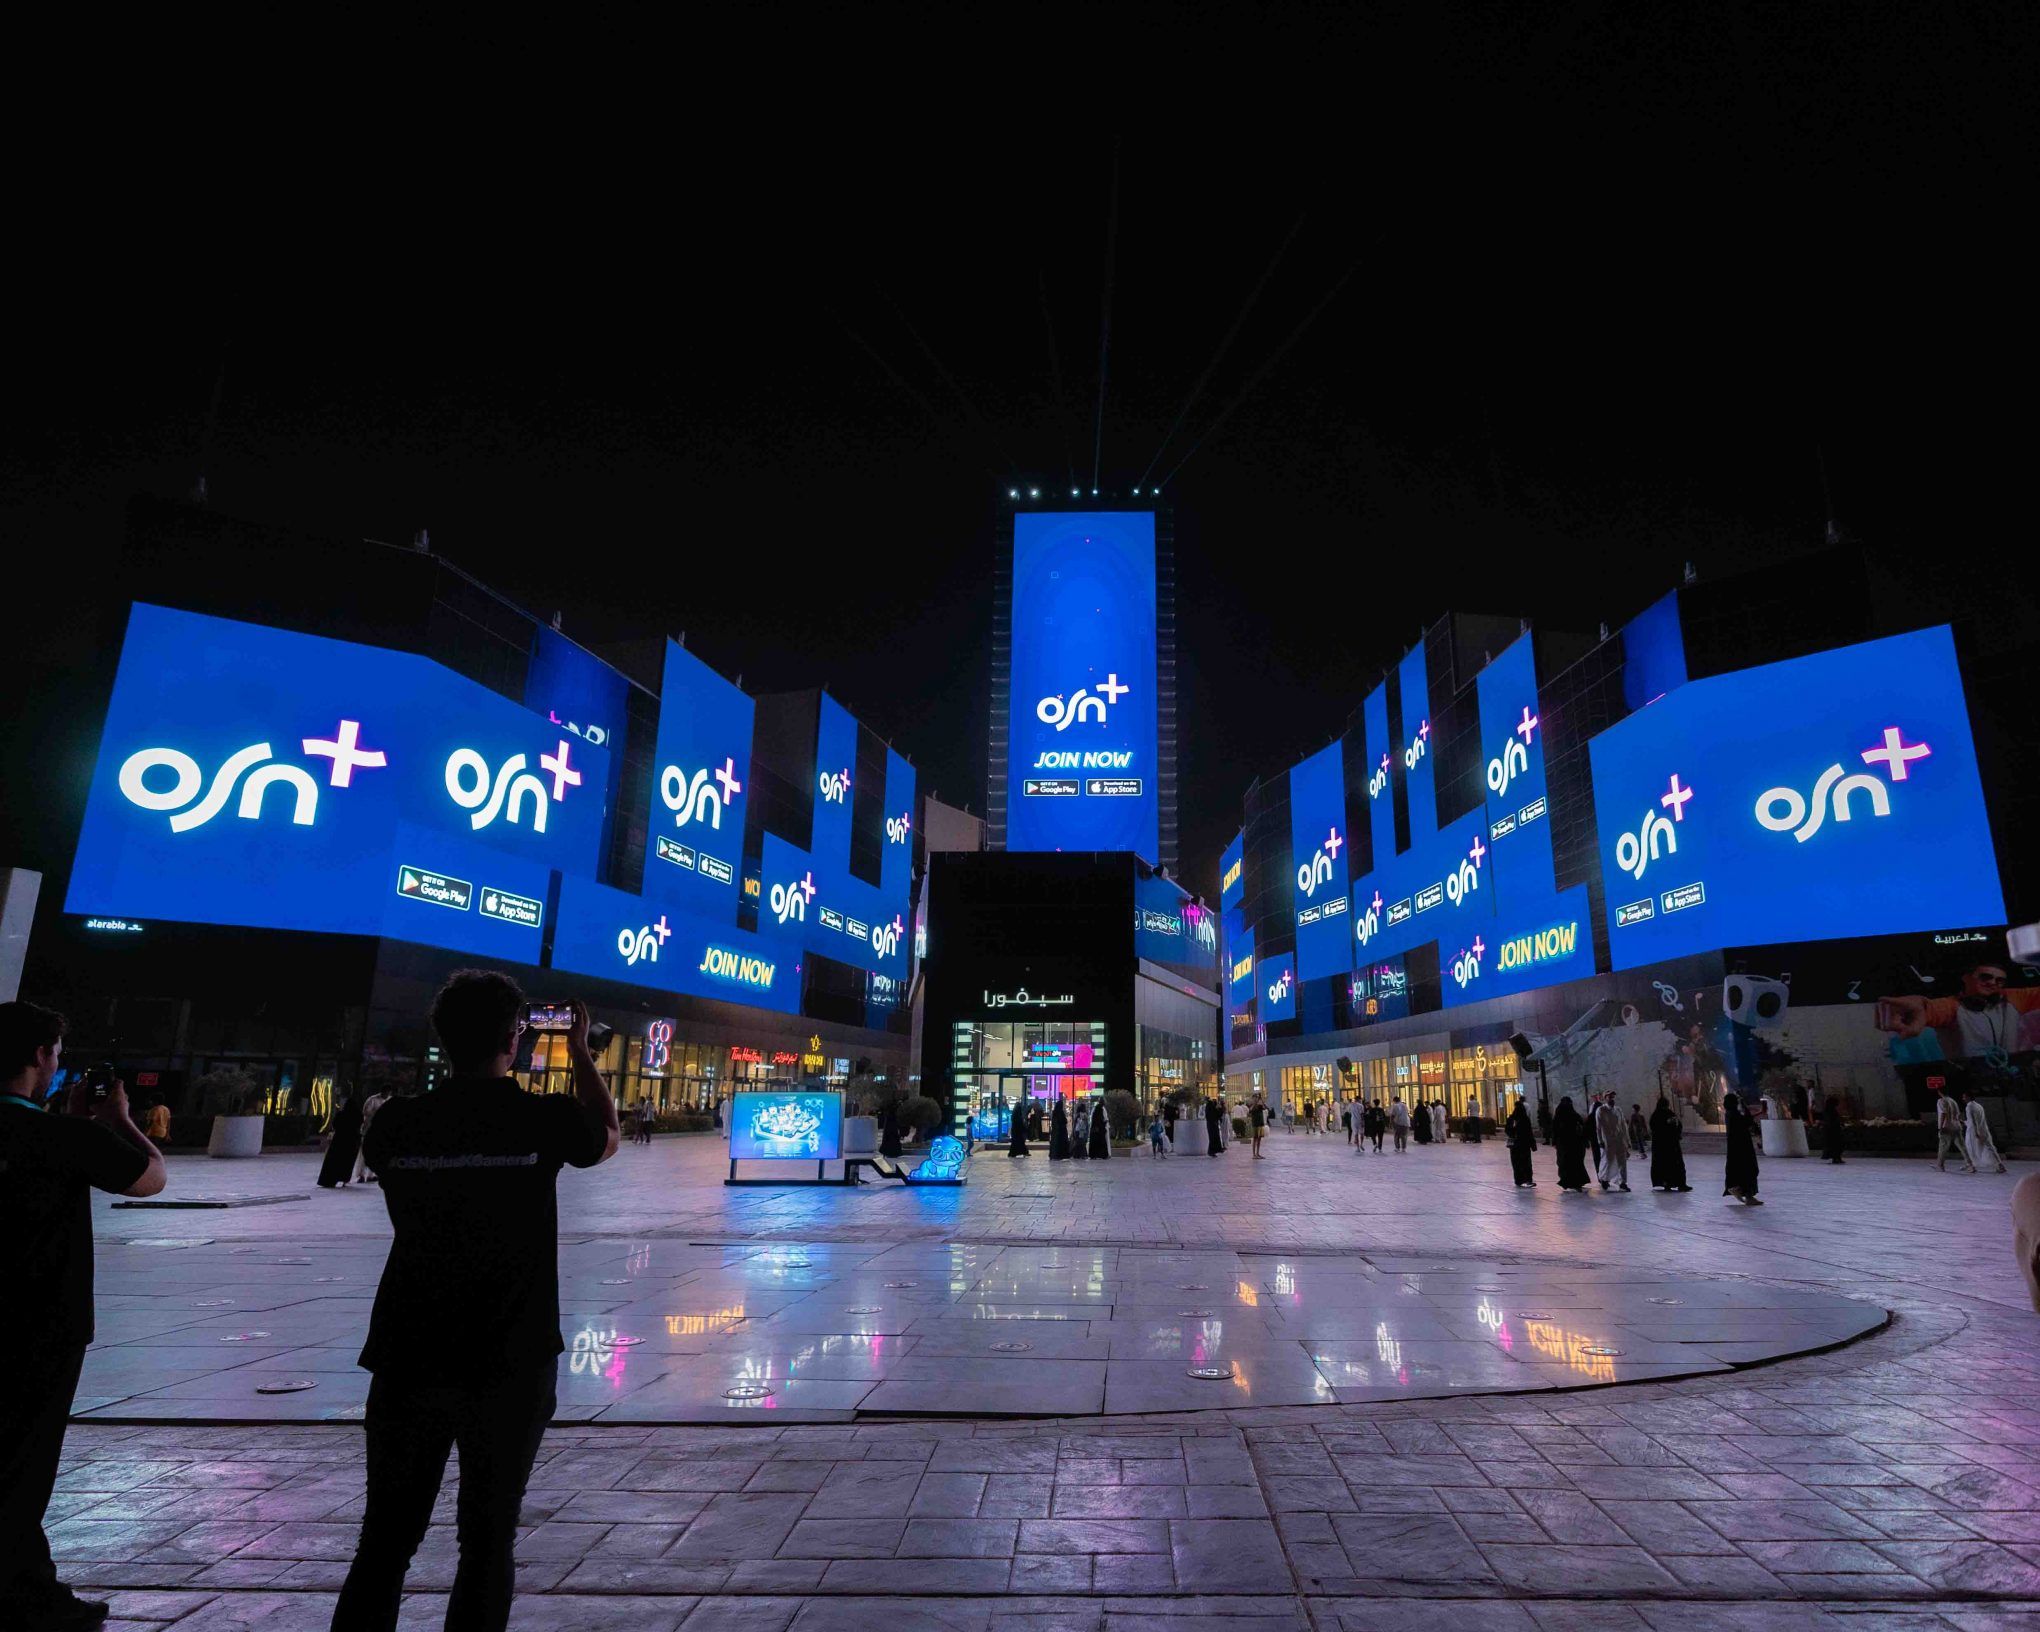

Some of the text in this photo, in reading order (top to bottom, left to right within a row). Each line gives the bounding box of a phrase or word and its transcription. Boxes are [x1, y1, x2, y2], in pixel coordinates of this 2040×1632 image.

[1034, 752, 1132, 768] JOIN NOW
[1040, 786, 1075, 794] Google Play
[1103, 785, 1137, 794] App Store
[420, 883, 467, 906] Google Play
[499, 903, 537, 923] App Store
[1498, 922, 1577, 971] JOIN NOW
[700, 947, 775, 987] JOIN NOW
[983, 987, 1074, 1008] سيفورا
[731, 1046, 742, 1060] Tim
